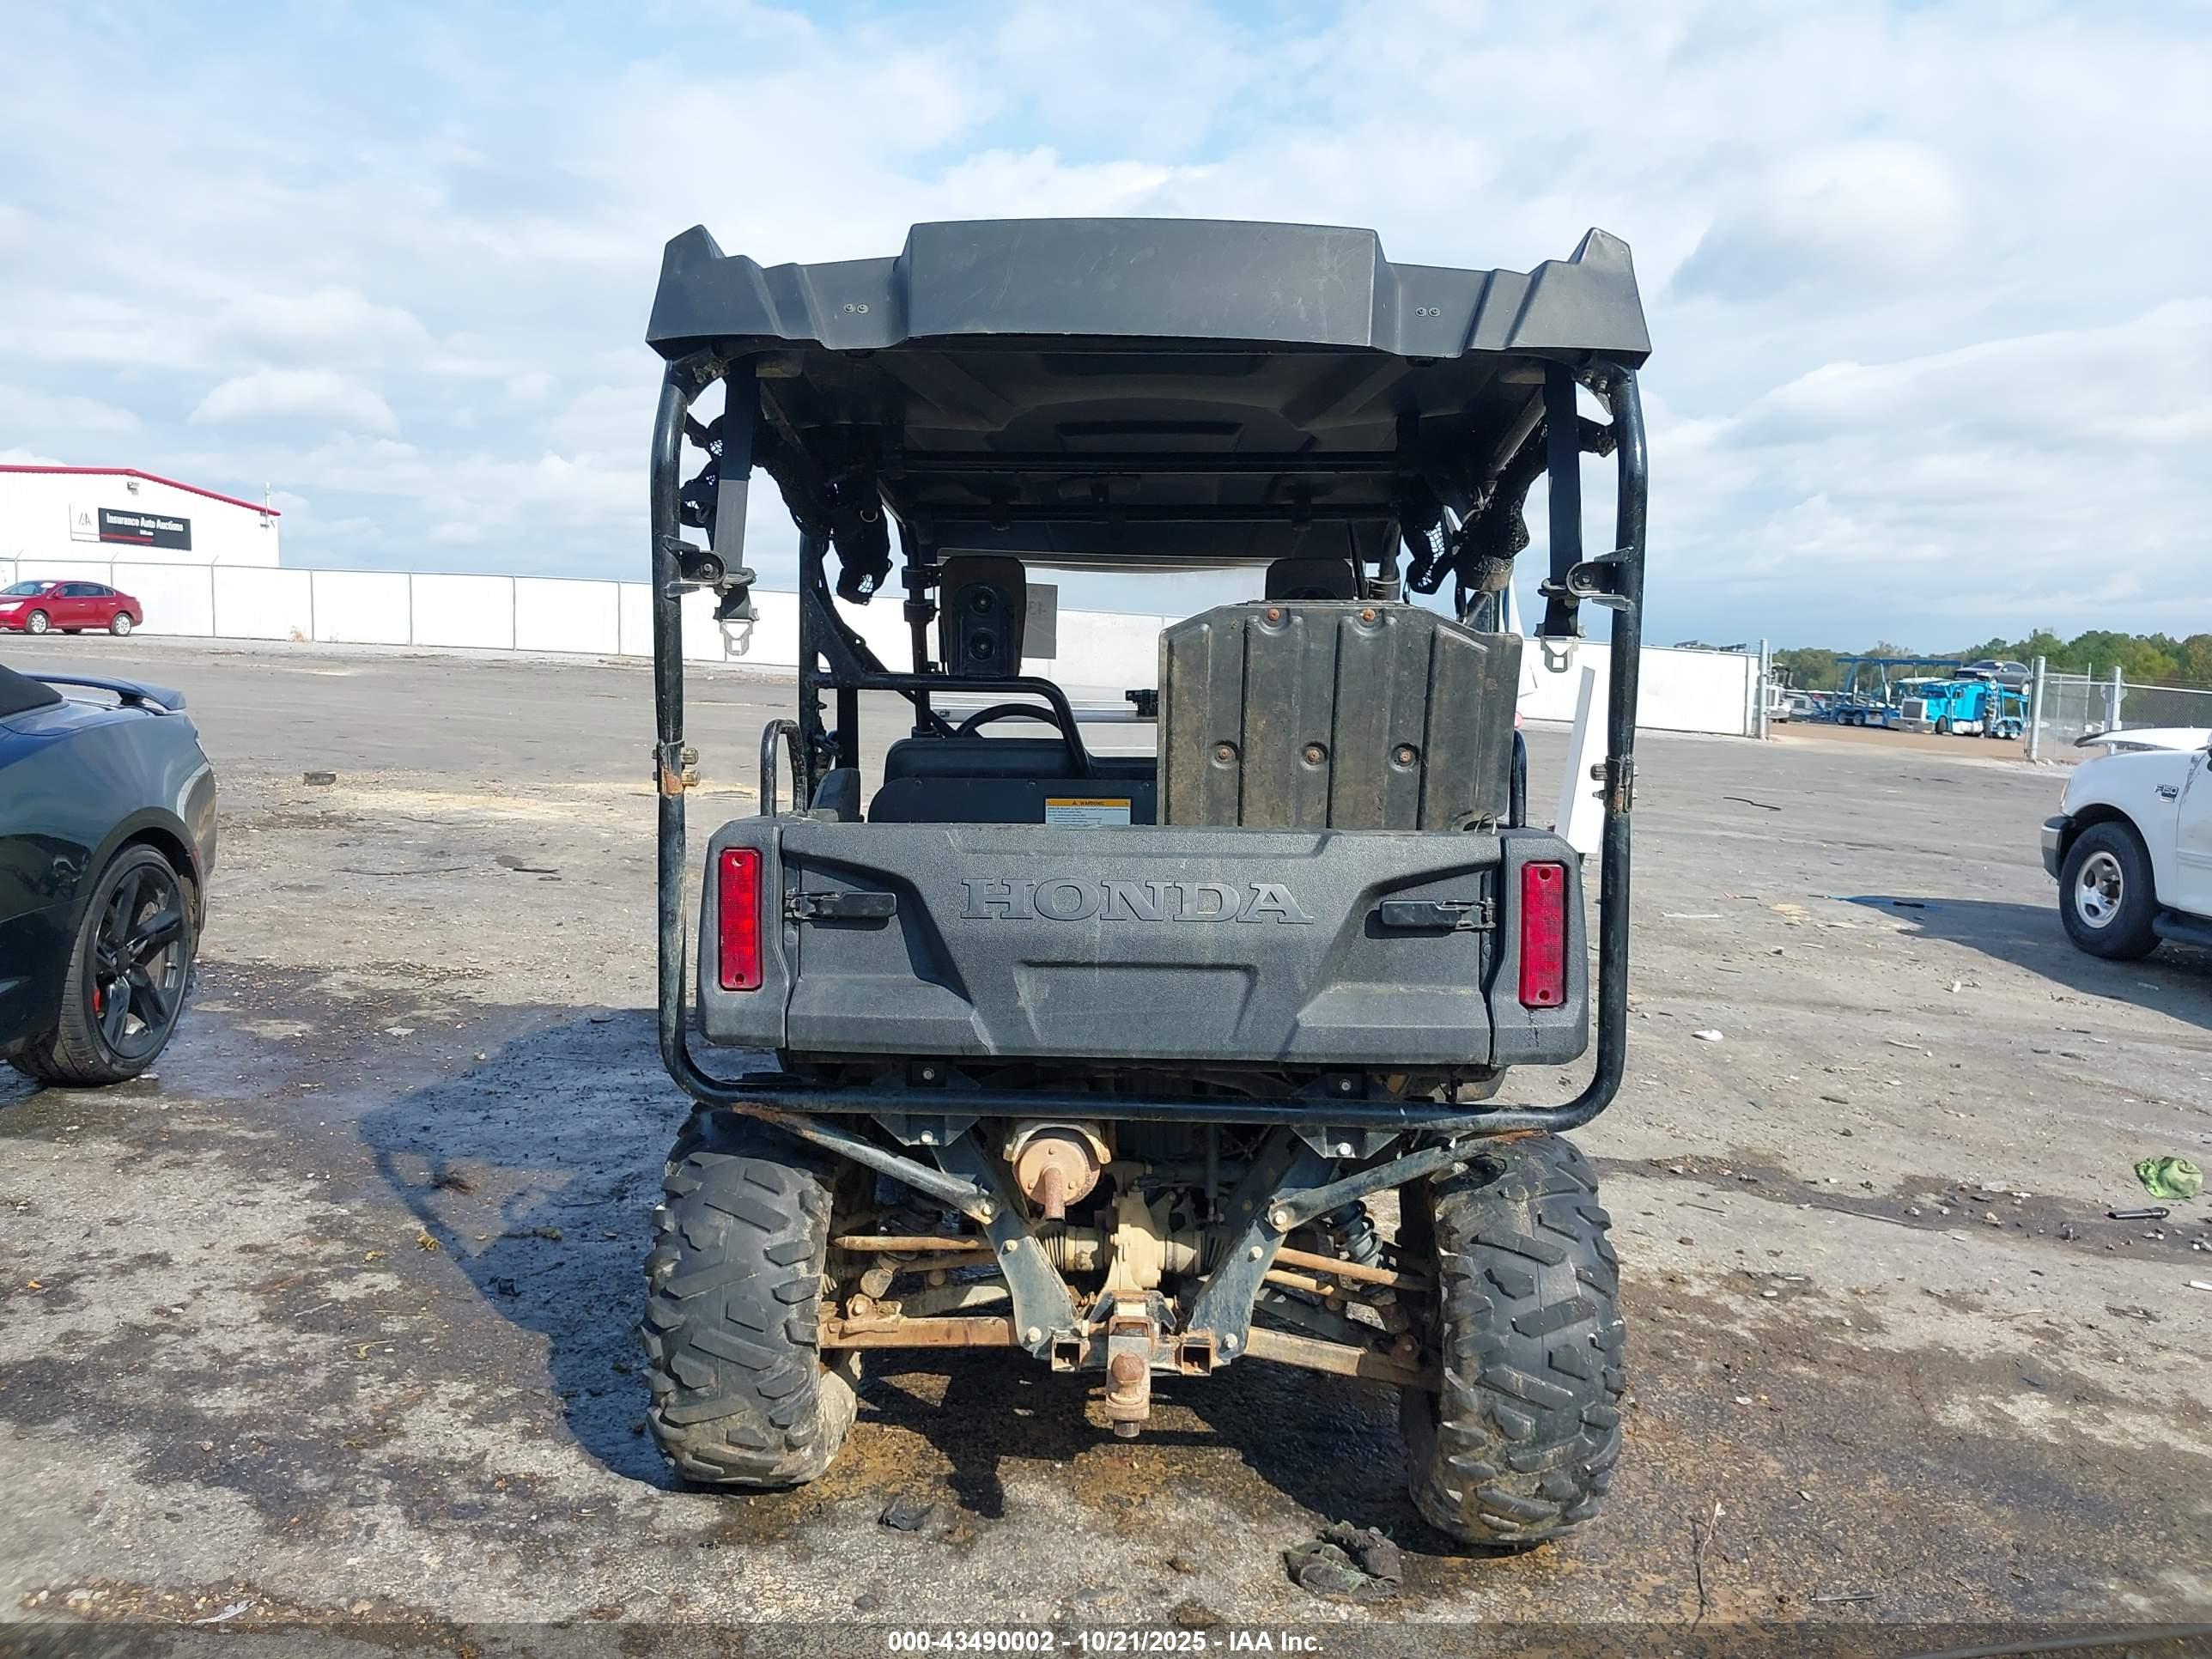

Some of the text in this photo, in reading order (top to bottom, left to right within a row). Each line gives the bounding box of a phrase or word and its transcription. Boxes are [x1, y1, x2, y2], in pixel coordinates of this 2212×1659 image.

[106, 513, 184, 532] Insurance Auto Auctions
[959, 878, 1315, 925] HONDA
